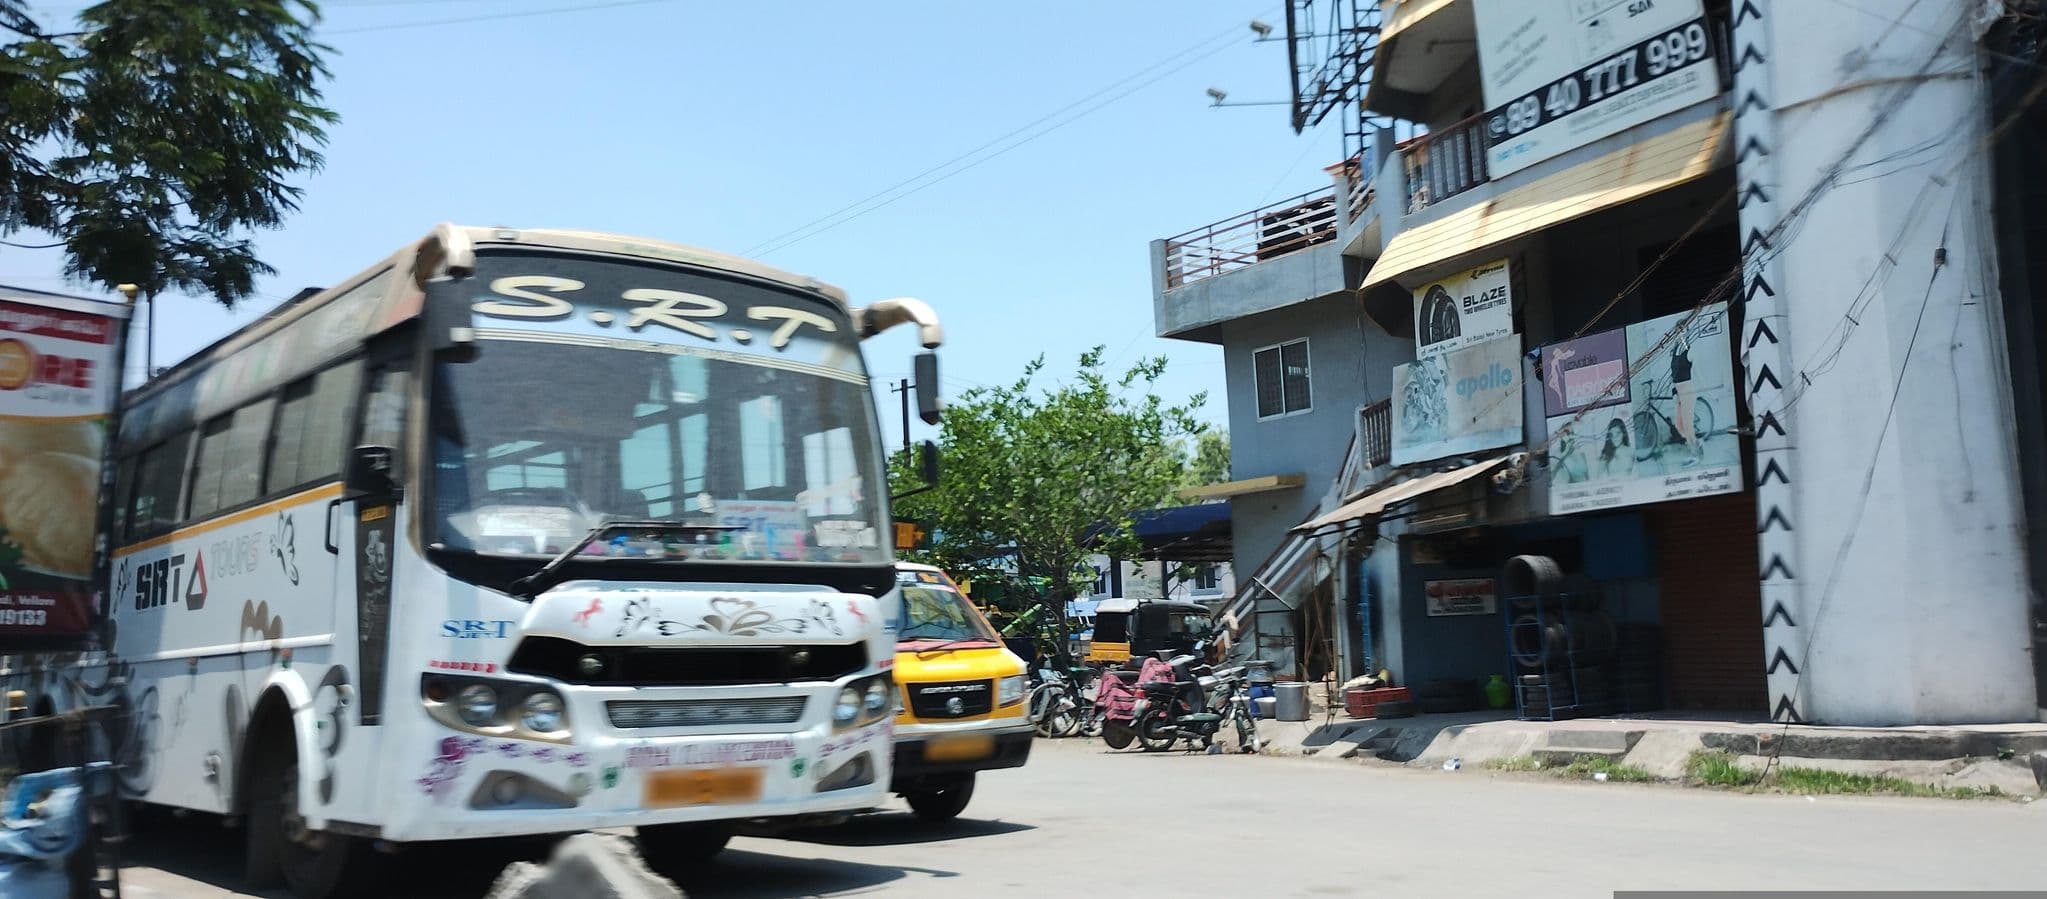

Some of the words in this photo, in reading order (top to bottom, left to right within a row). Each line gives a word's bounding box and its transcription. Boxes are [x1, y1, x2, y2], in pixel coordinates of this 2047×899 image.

[1506, 95, 1541, 134] 89
[1544, 77, 1581, 117] 40
[1583, 49, 1639, 101] 777
[1645, 23, 1707, 76] 999
[471, 275, 838, 351] S.R.T
[1463, 285, 1506, 308] BLAZE
[1493, 297, 1507, 309] TYRES
[1456, 363, 1512, 399] apollo
[135, 554, 186, 611] SRT
[211, 532, 263, 581] TOURS
[441, 619, 515, 639] SRT
